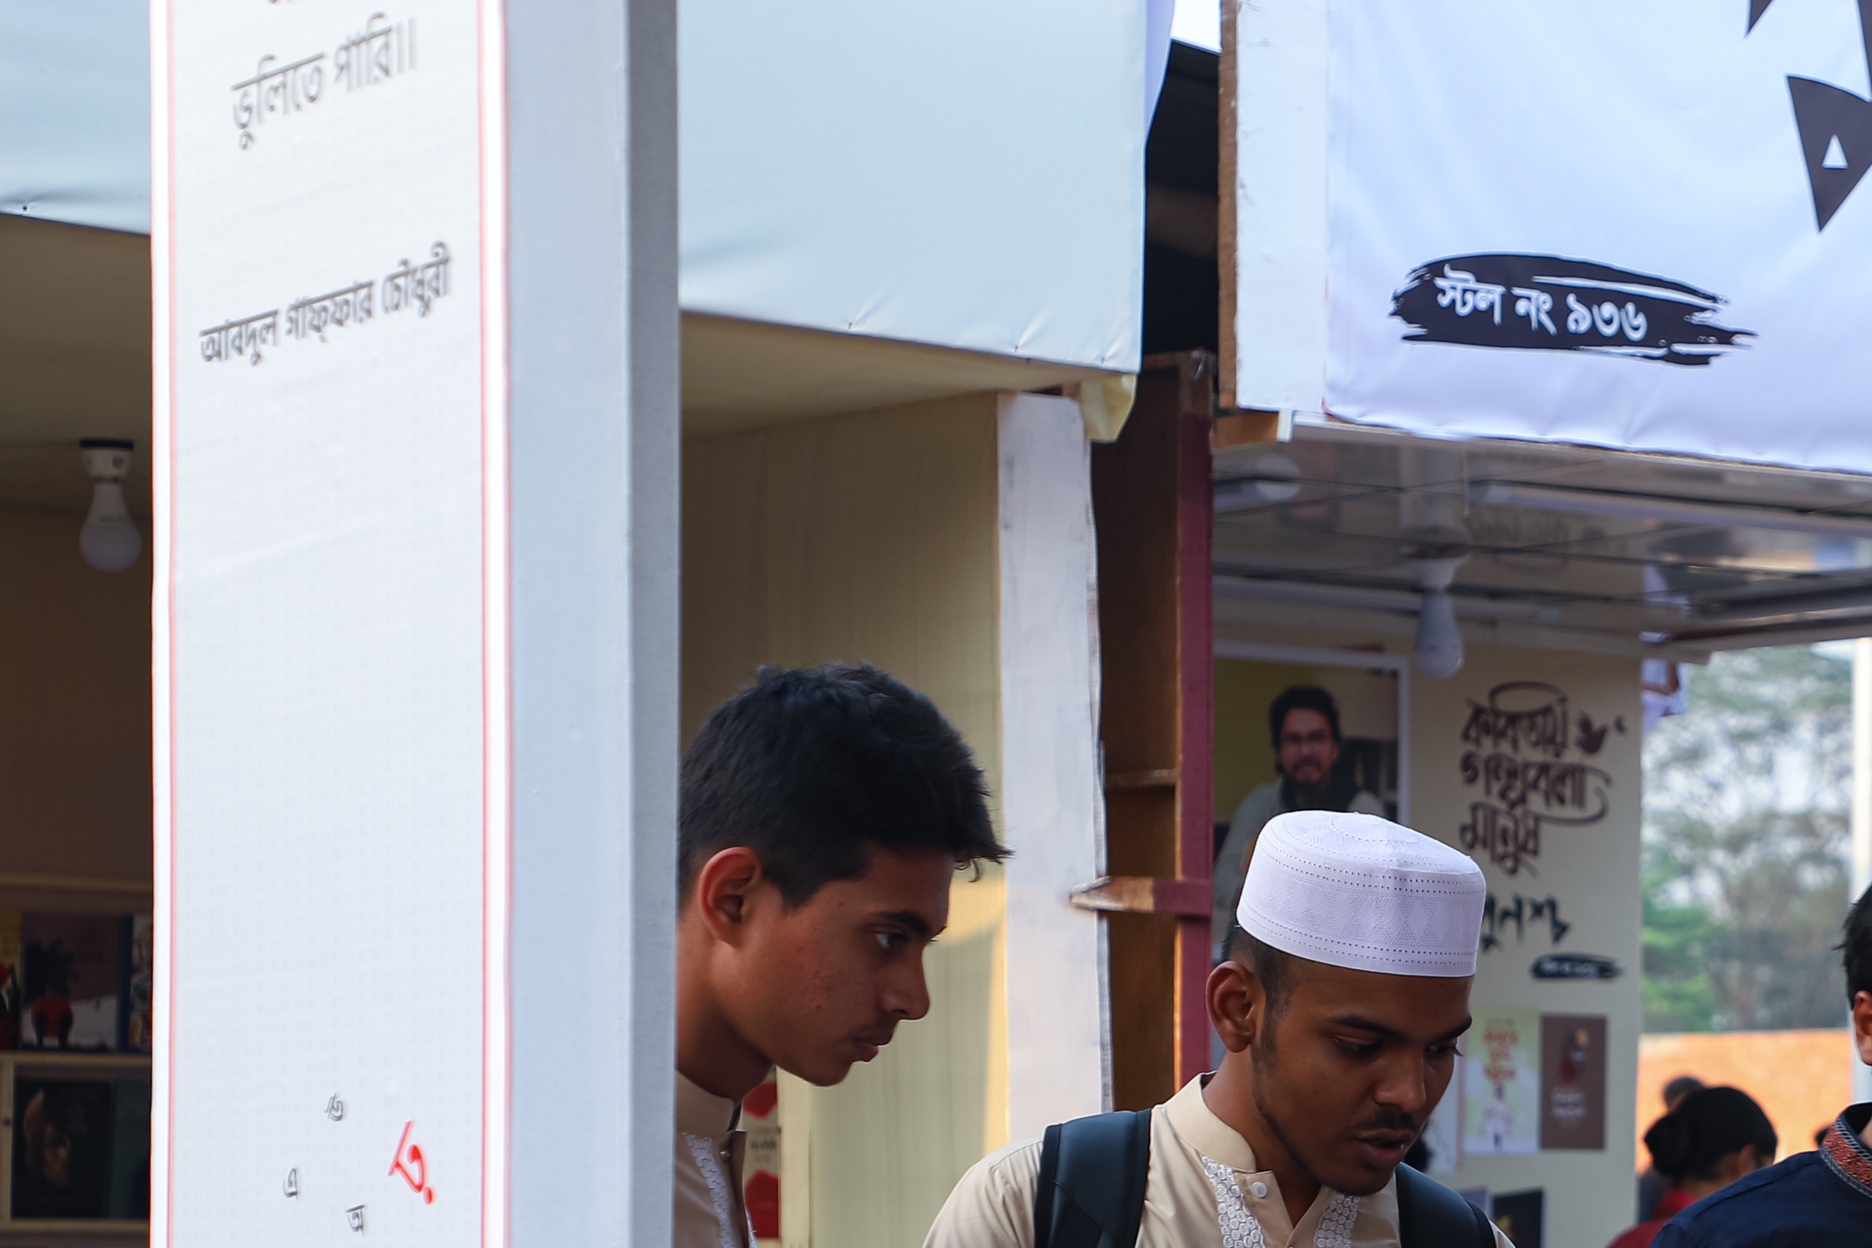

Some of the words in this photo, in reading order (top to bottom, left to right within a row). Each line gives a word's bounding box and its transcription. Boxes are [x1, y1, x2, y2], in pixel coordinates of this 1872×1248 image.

[231, 54, 326, 149] ভুলিতে
[198, 308, 280, 367] আবদুল
[381, 241, 451, 318] চৌধুরী
[1433, 263, 1506, 326] স্টল
[1511, 286, 1558, 336] নং
